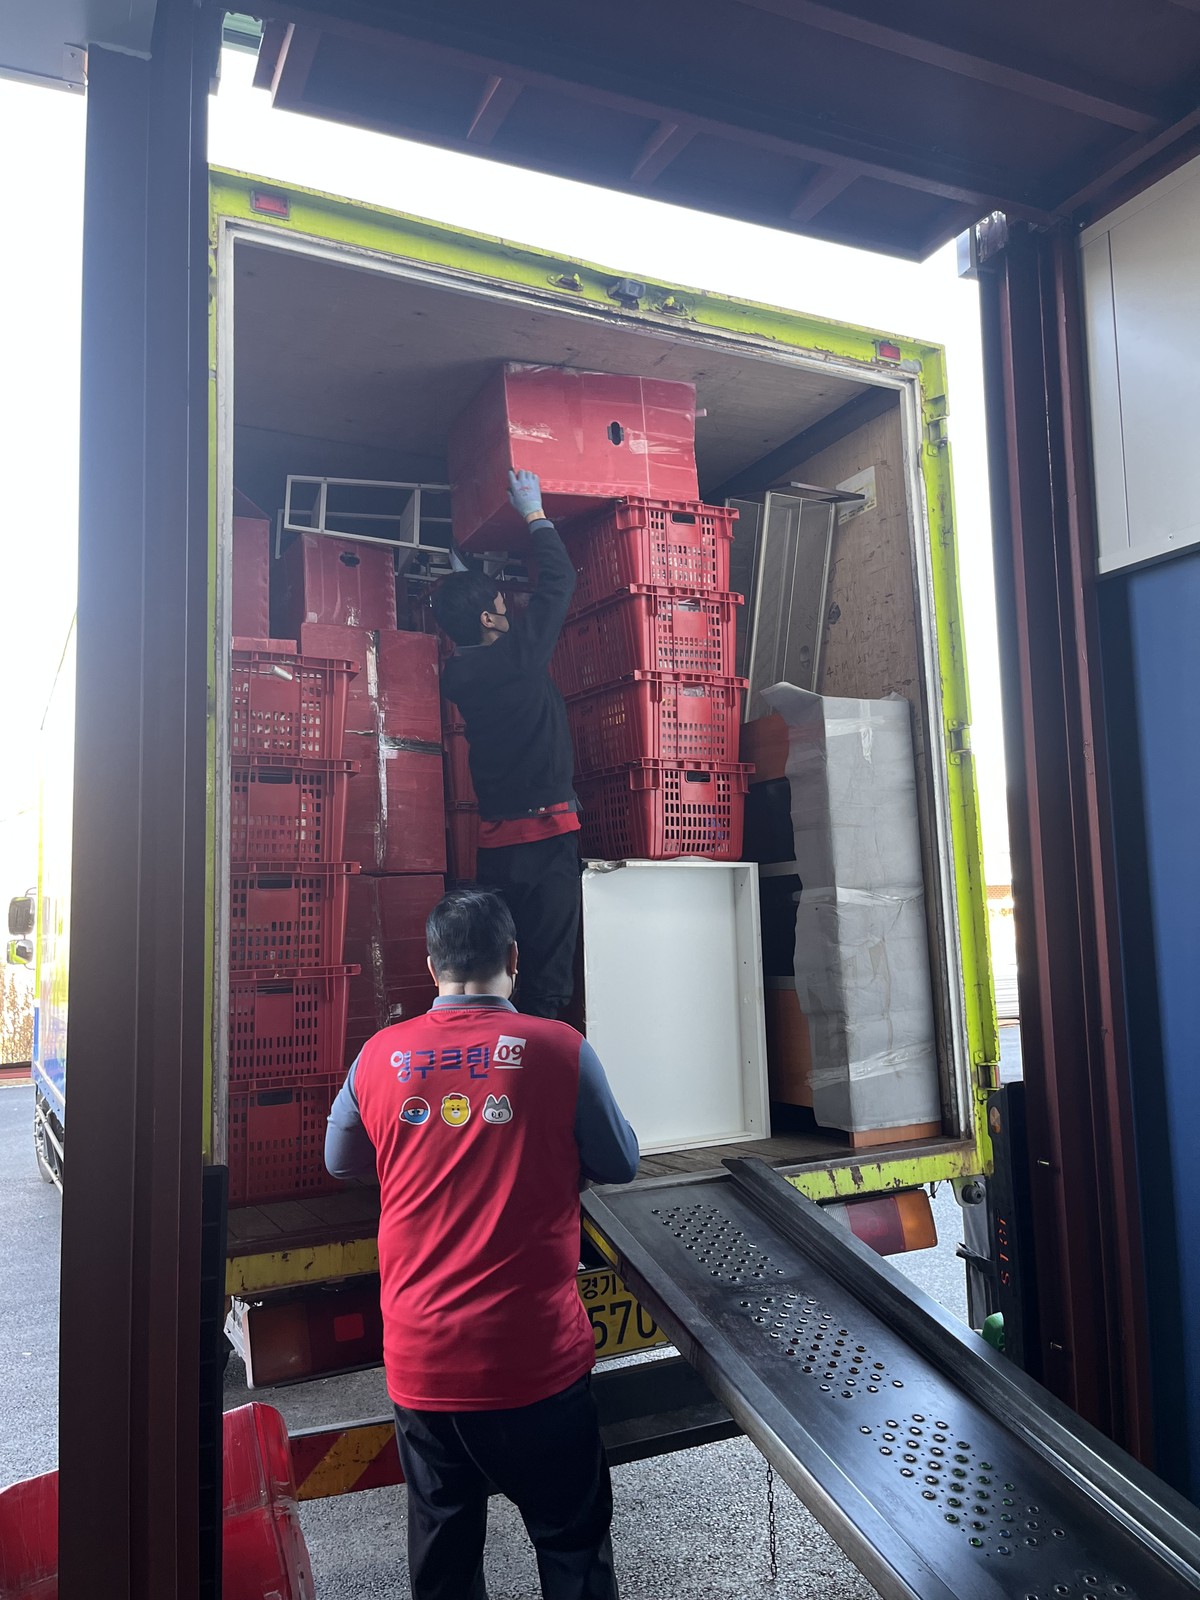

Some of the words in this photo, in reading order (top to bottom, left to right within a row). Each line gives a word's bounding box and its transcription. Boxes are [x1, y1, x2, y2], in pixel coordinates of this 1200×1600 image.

[390, 1047, 490, 1083] 영구크린
[497, 1044, 525, 1062] 09
[581, 1273, 616, 1299] 경기
[587, 1300, 658, 1349] 570
